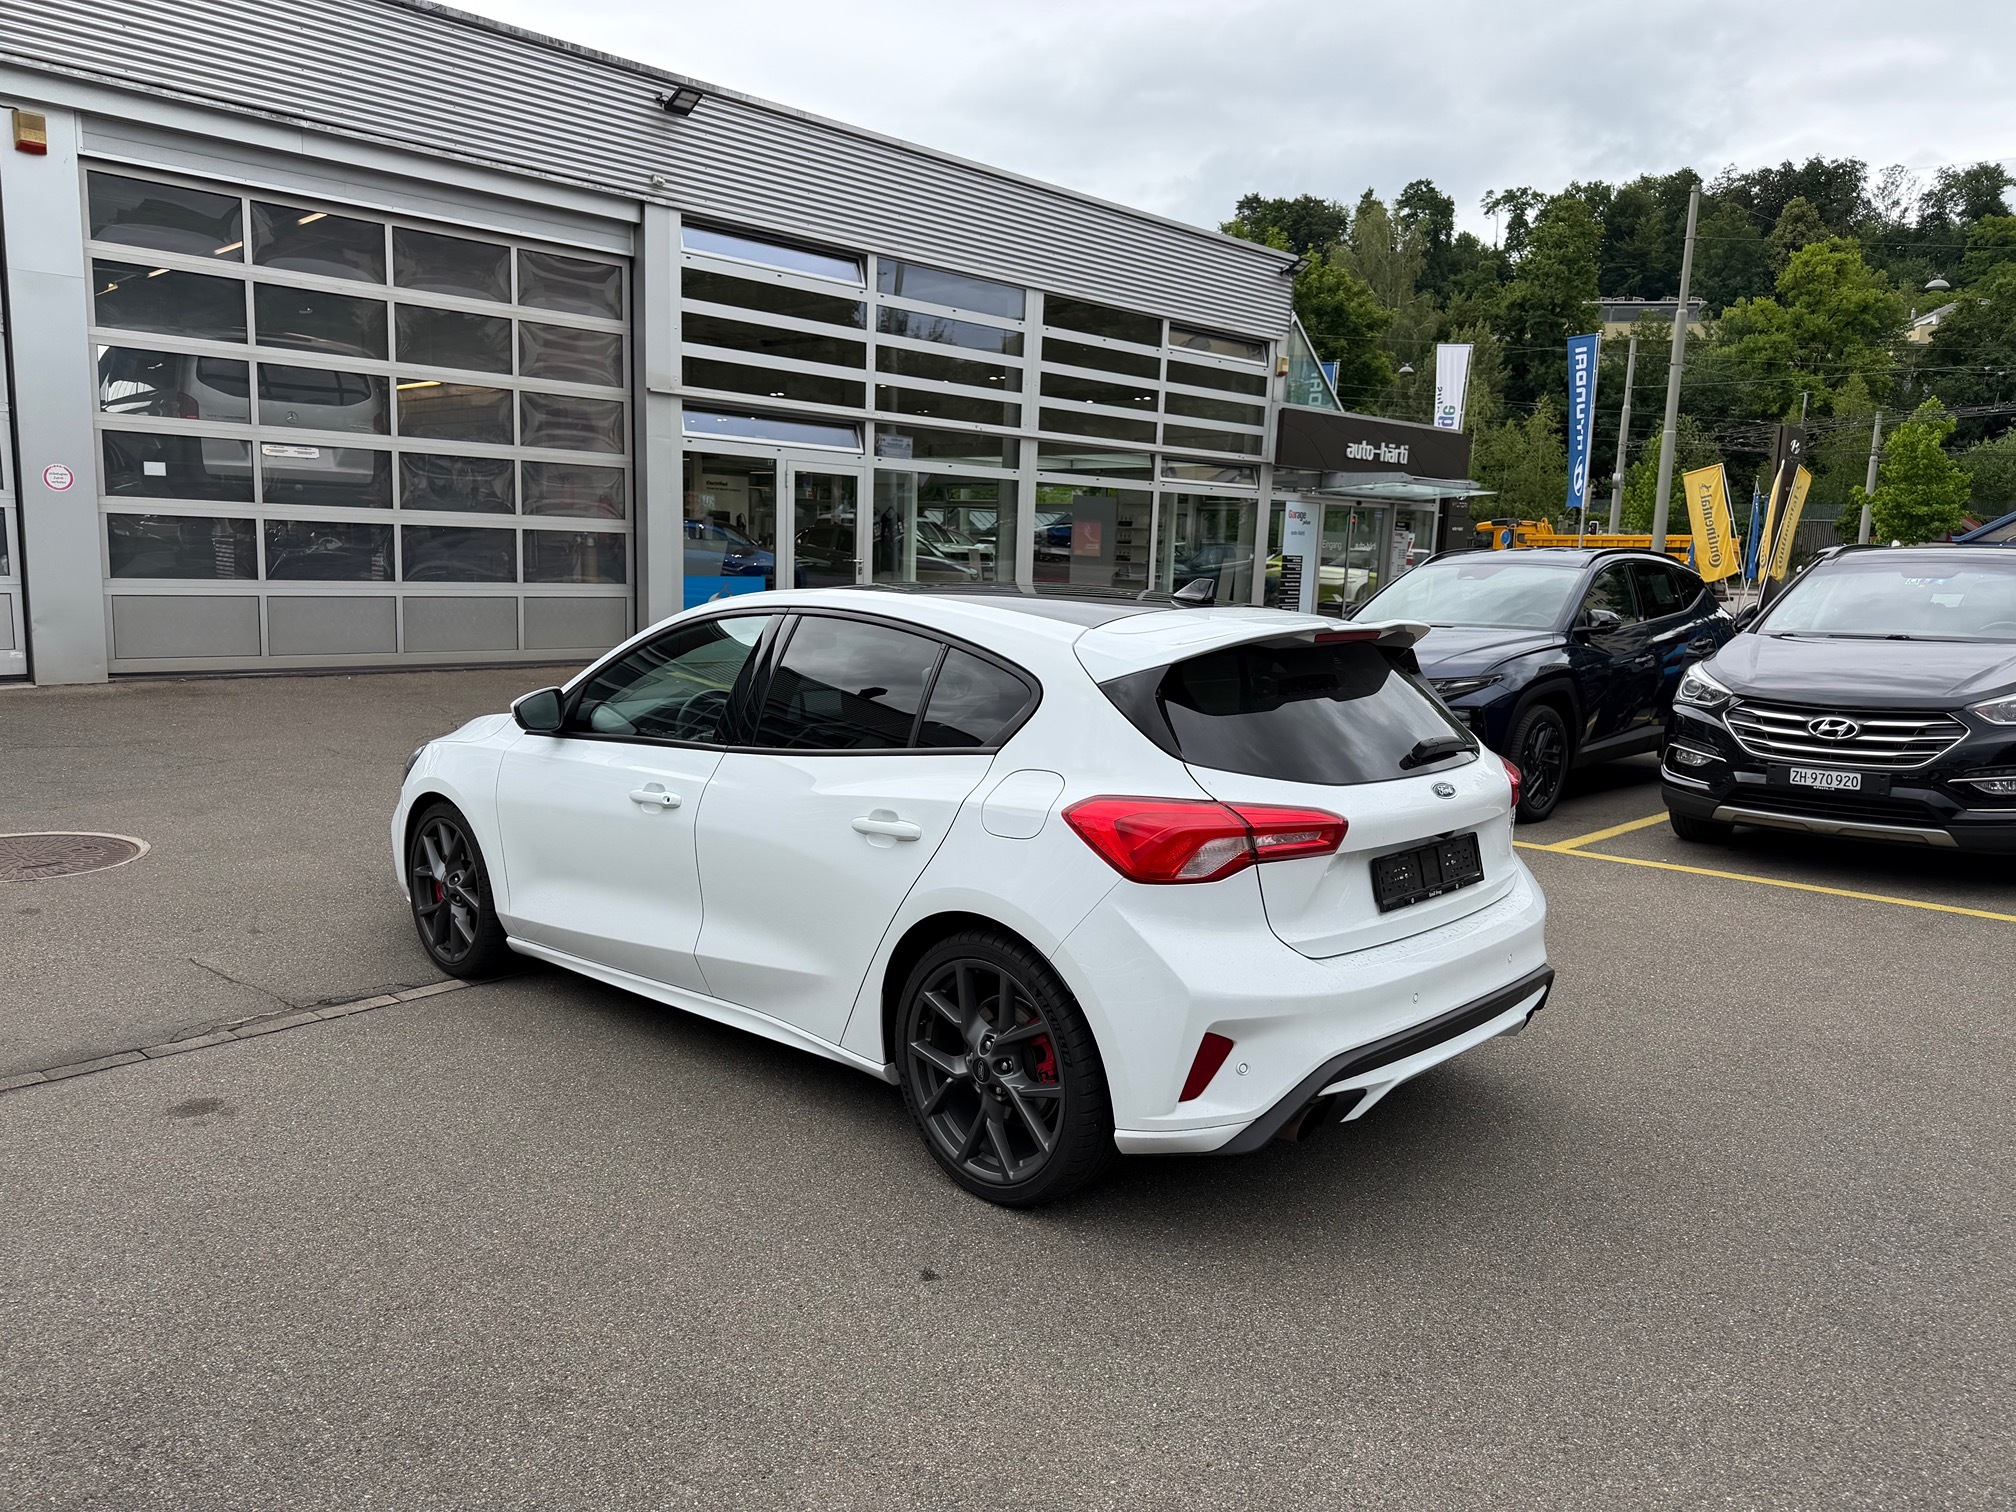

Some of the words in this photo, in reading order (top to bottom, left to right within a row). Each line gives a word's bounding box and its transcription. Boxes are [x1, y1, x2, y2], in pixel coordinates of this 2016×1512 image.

[1346, 440, 1409, 465] auto-härti
[1288, 510, 1307, 521] Garage
[1322, 540, 1342, 551] Eingang
[1835, 774, 1859, 788] 920
